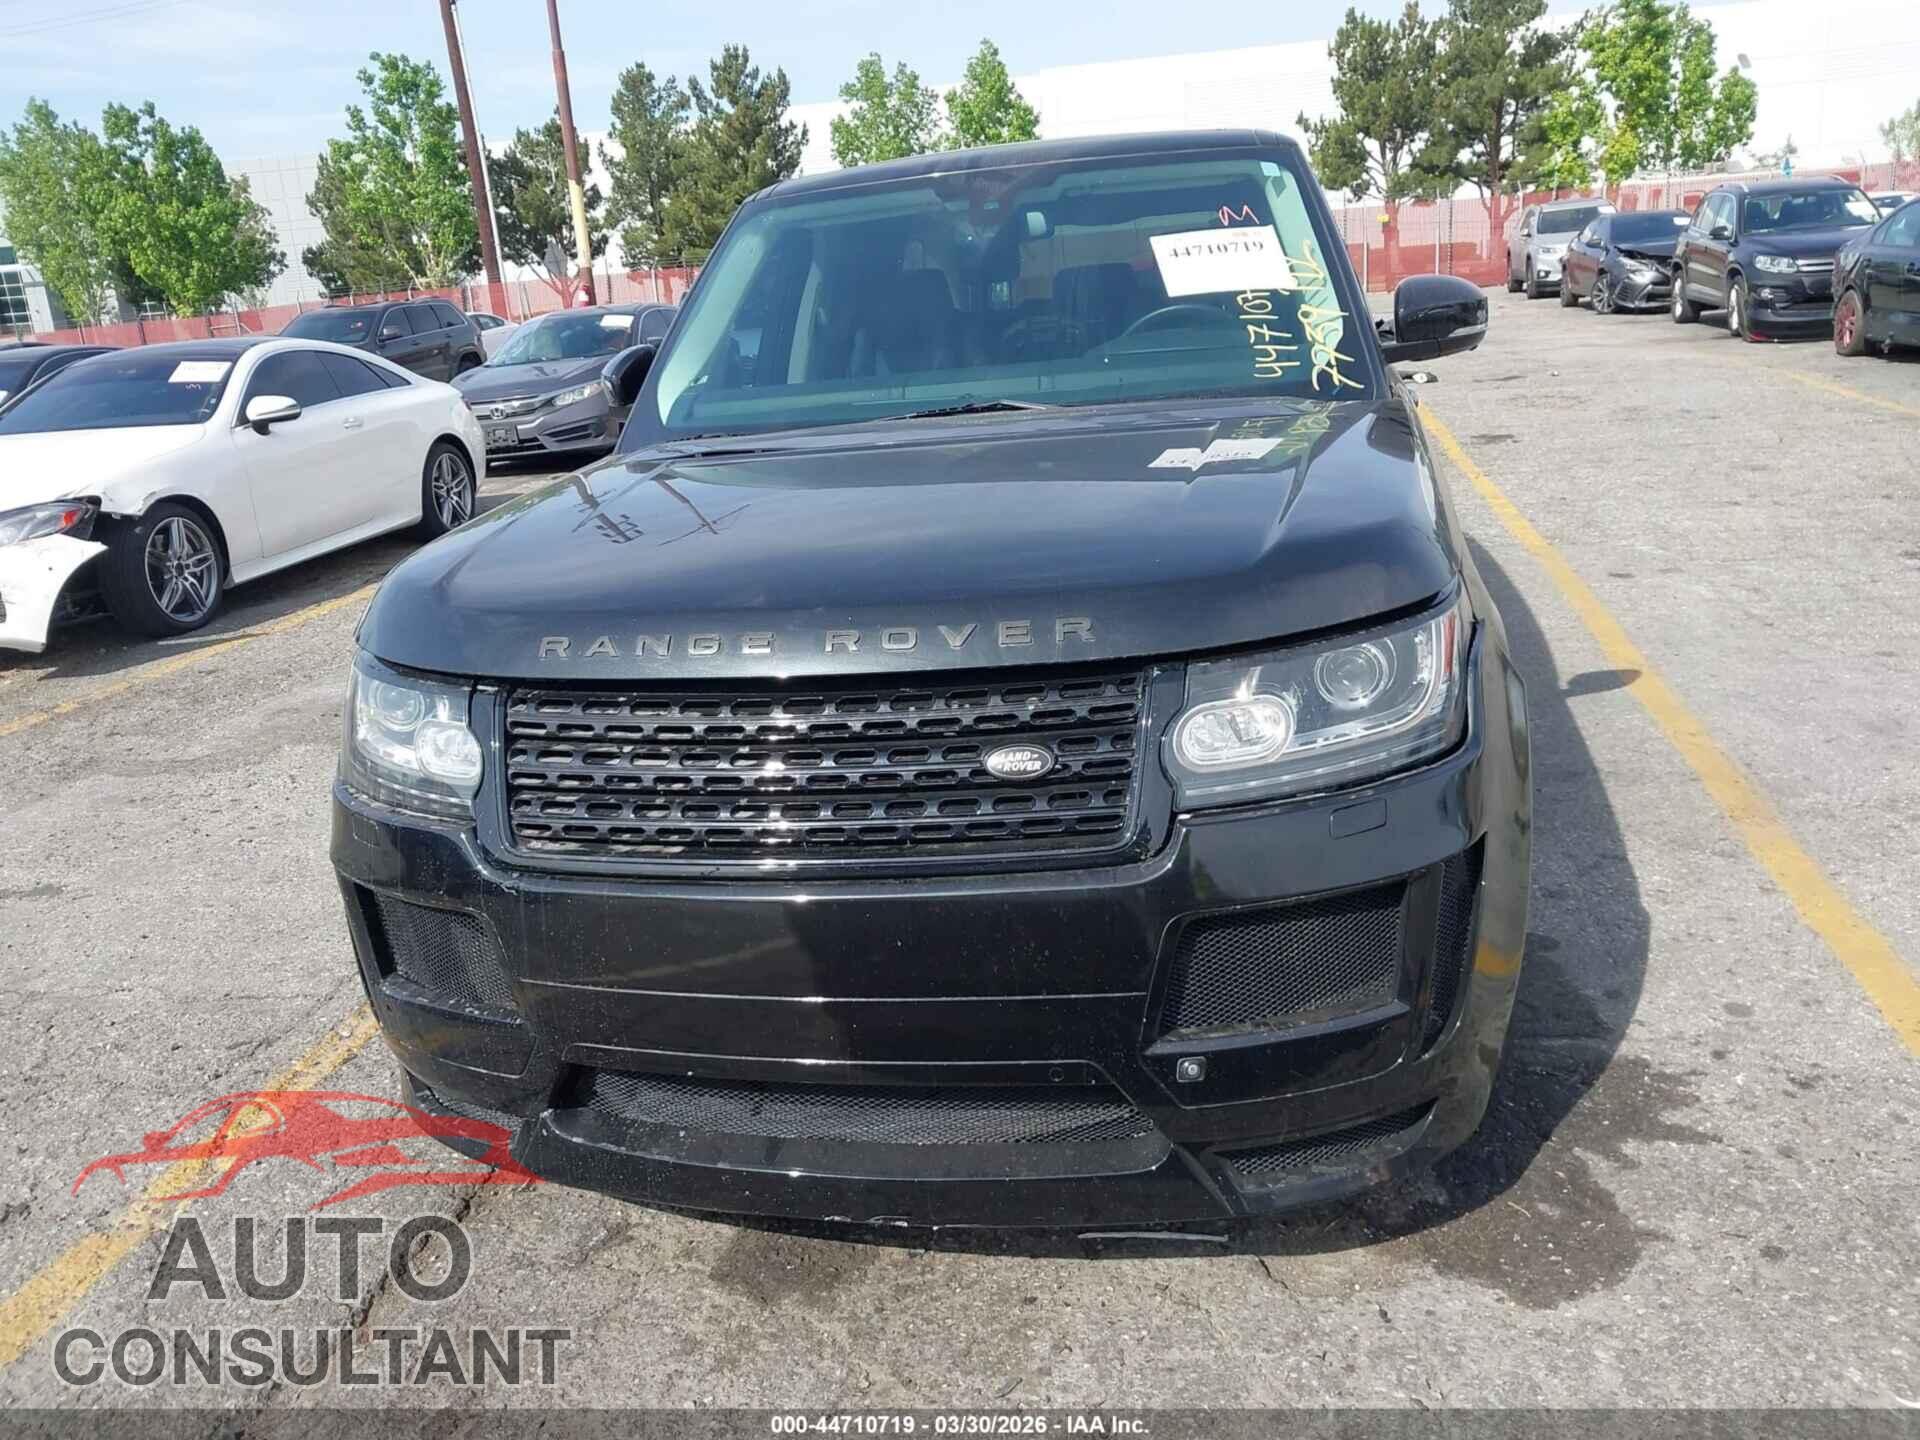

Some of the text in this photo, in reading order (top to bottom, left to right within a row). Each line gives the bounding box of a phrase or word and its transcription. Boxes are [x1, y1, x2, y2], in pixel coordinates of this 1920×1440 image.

[1168, 241, 1264, 258] 44710719
[537, 616, 1096, 659] RANGE ROVER
